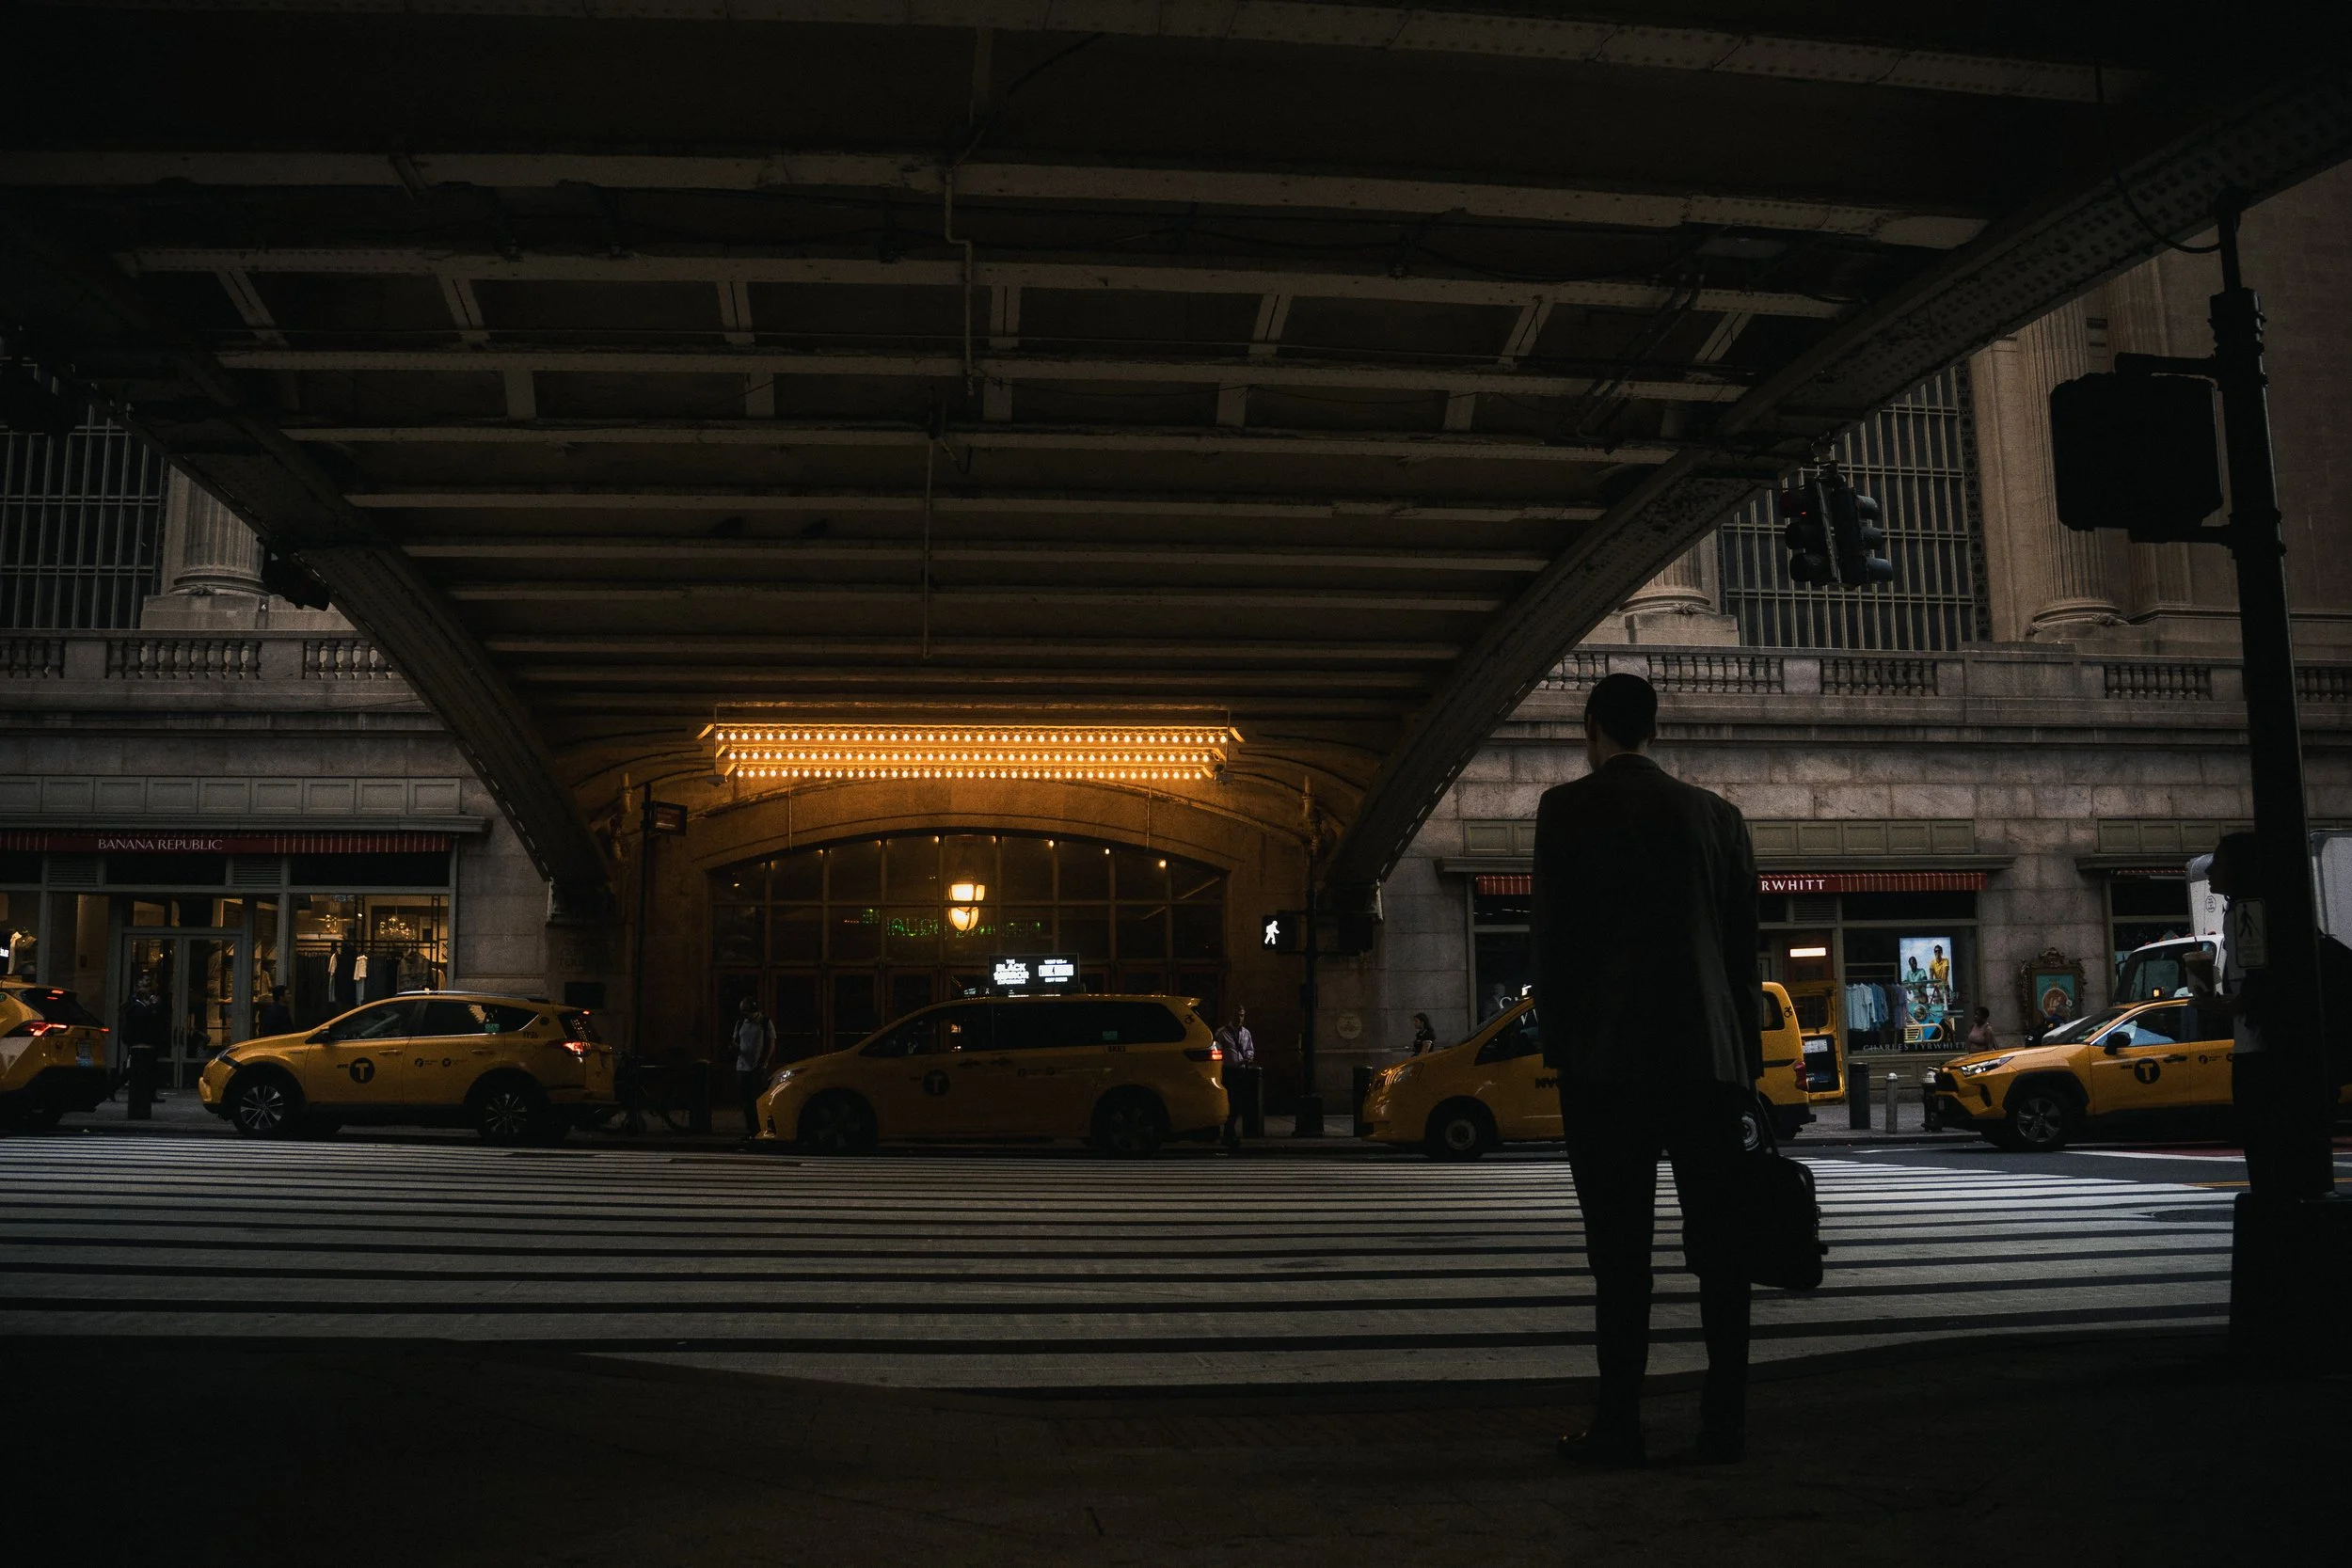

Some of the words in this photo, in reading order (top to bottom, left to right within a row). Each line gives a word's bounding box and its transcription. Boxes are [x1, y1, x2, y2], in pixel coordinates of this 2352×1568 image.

[98, 838, 154, 850] BANANA
[158, 838, 223, 850] REPUBLIC
[1761, 879, 1825, 891] RWHITT
[1863, 1043, 1909, 1052] CHARLES
[1915, 1041, 1965, 1051] TYRWHITT
